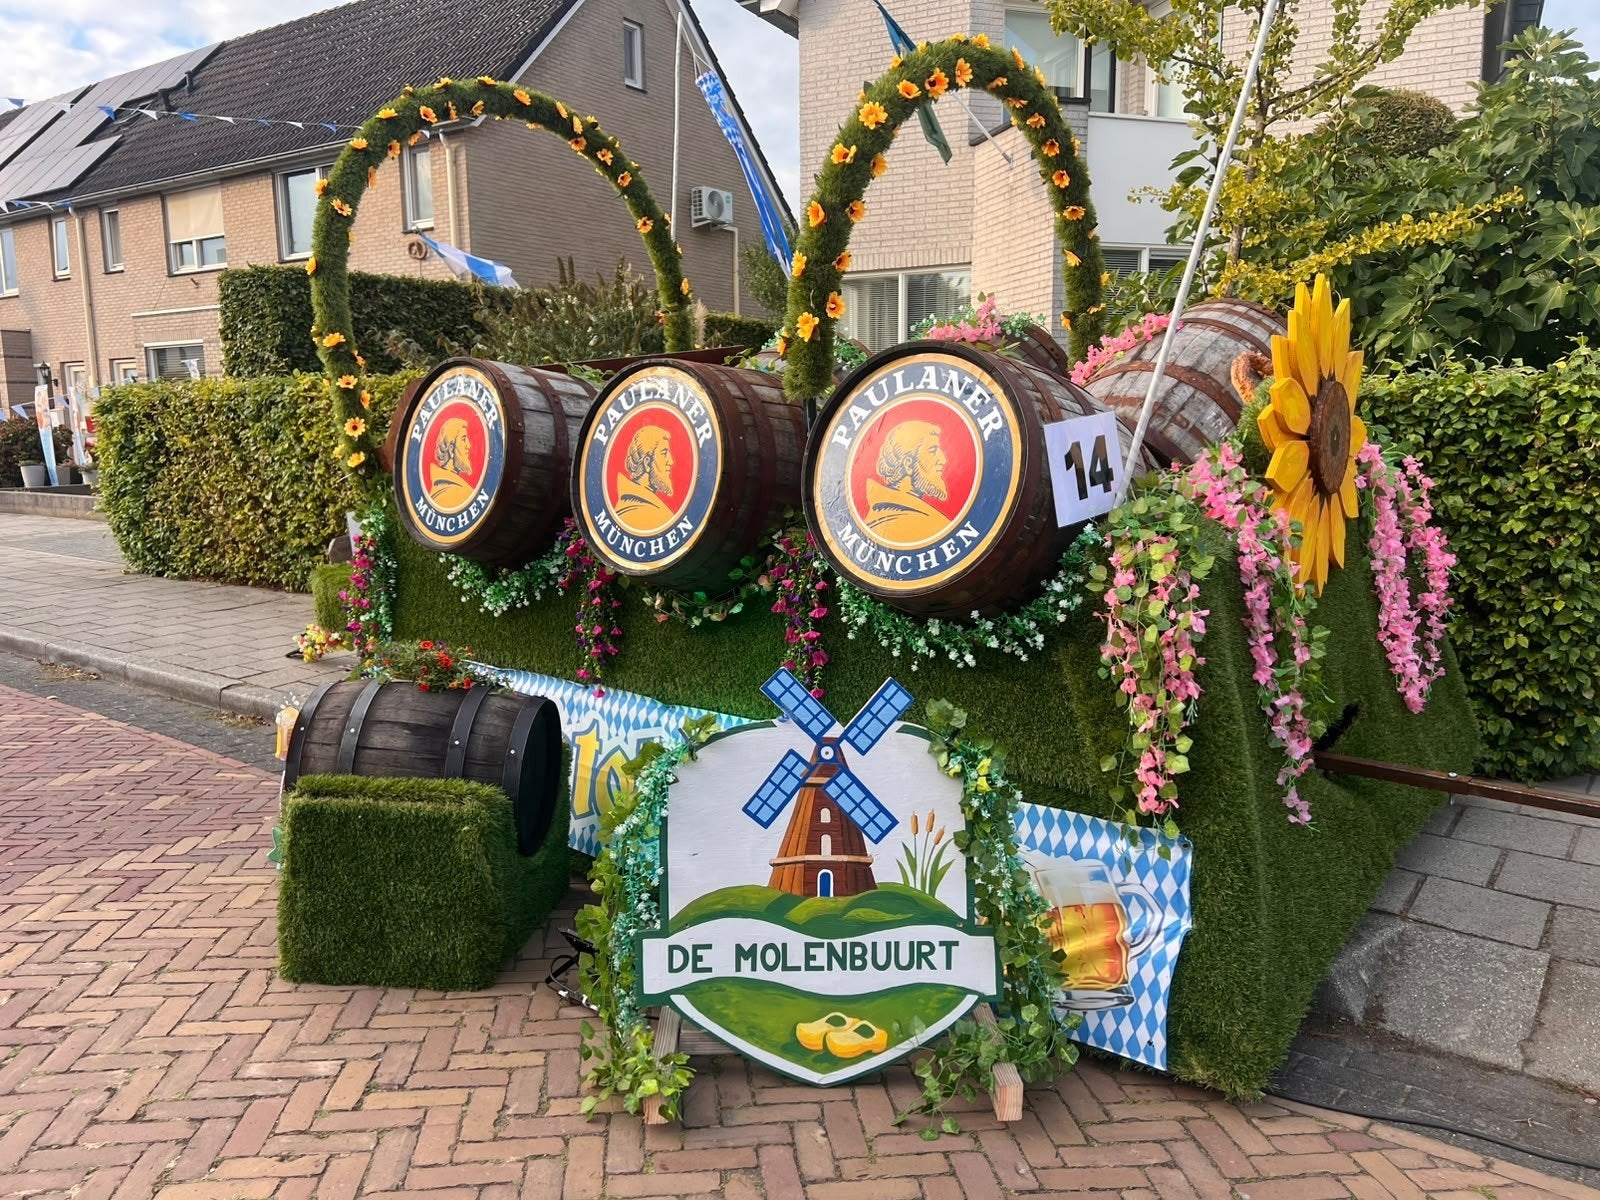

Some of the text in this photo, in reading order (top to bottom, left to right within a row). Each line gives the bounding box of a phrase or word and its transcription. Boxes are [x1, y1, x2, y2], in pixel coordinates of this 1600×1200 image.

[411, 375, 498, 443] PAULANER
[593, 378, 714, 449] PAULANER
[831, 365, 1004, 450] PAULANER
[1063, 434, 1115, 501] 14
[415, 488, 490, 533] MÜNCHEN
[594, 508, 694, 559] MÜNCHEN
[837, 520, 981, 576] MÜNCHEN
[667, 940, 960, 974] DE MOLENBUURT
